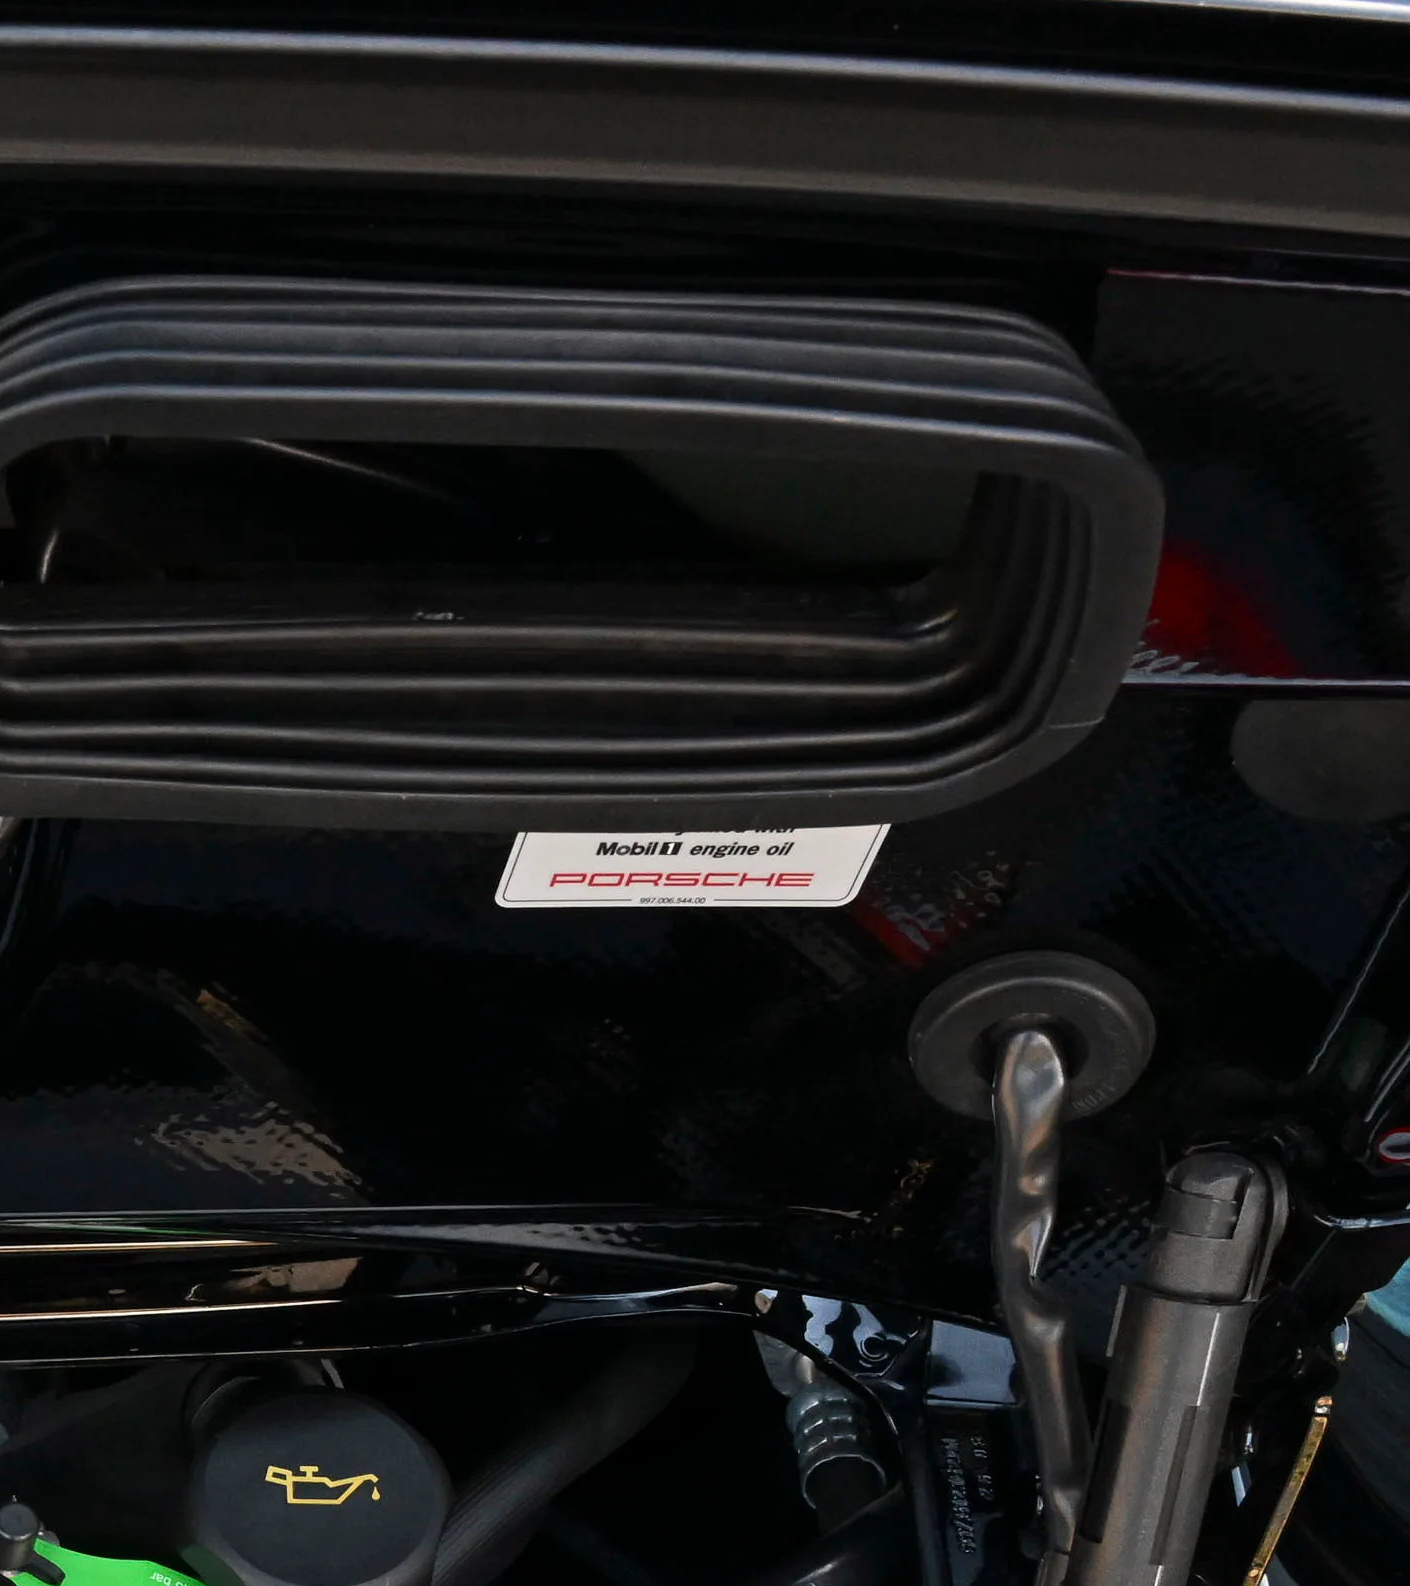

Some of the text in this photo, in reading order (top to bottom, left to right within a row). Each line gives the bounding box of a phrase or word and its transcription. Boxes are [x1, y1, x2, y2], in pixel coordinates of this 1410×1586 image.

[689, 842, 760, 859] engine
[766, 841, 795, 856] oil
[548, 872, 815, 887] PORSCHE
